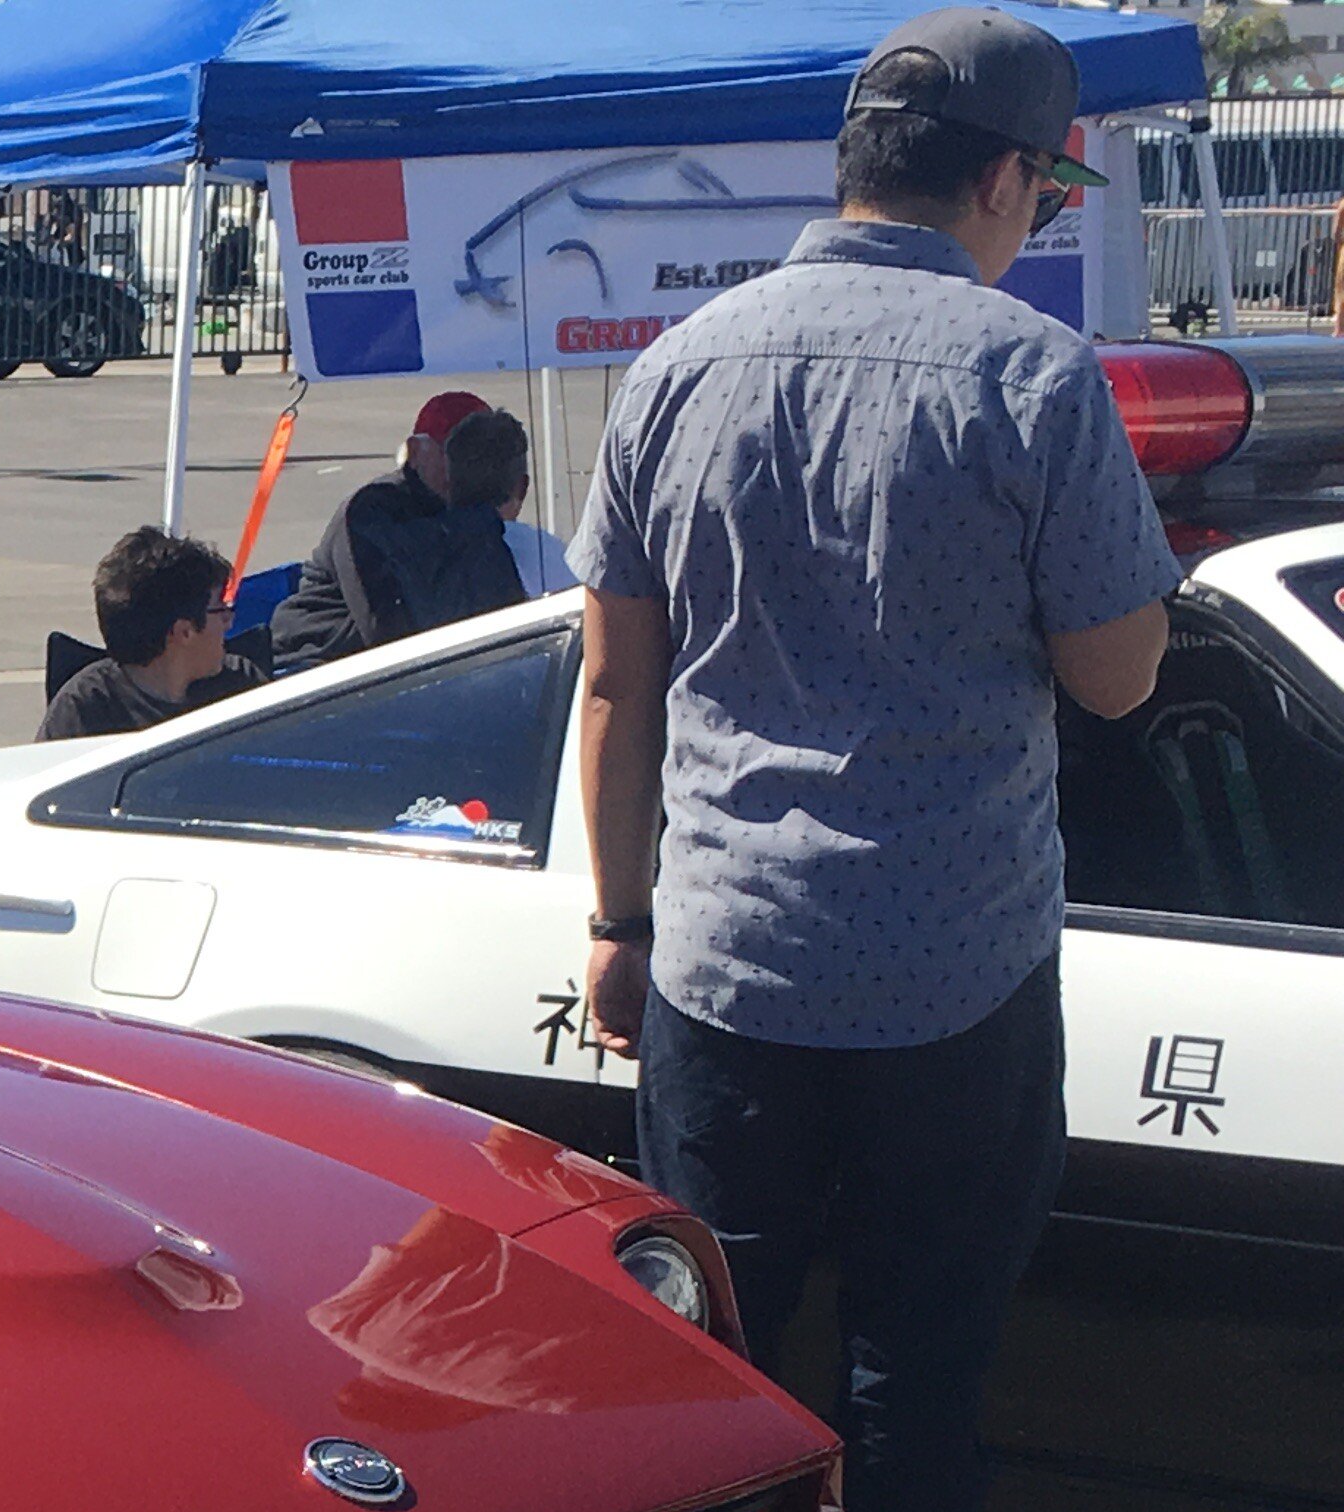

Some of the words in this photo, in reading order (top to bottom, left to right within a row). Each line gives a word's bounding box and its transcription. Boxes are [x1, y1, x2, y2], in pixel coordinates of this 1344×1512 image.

[1024, 240, 1047, 251] car
[1050, 235, 1080, 250] club
[302, 251, 369, 273] Group
[307, 272, 350, 289] sports
[353, 273, 376, 285] car
[380, 270, 410, 284] club
[652, 257, 783, 291] Est.197
[474, 821, 523, 839] HKS
[1137, 1034, 1226, 1137] 県
